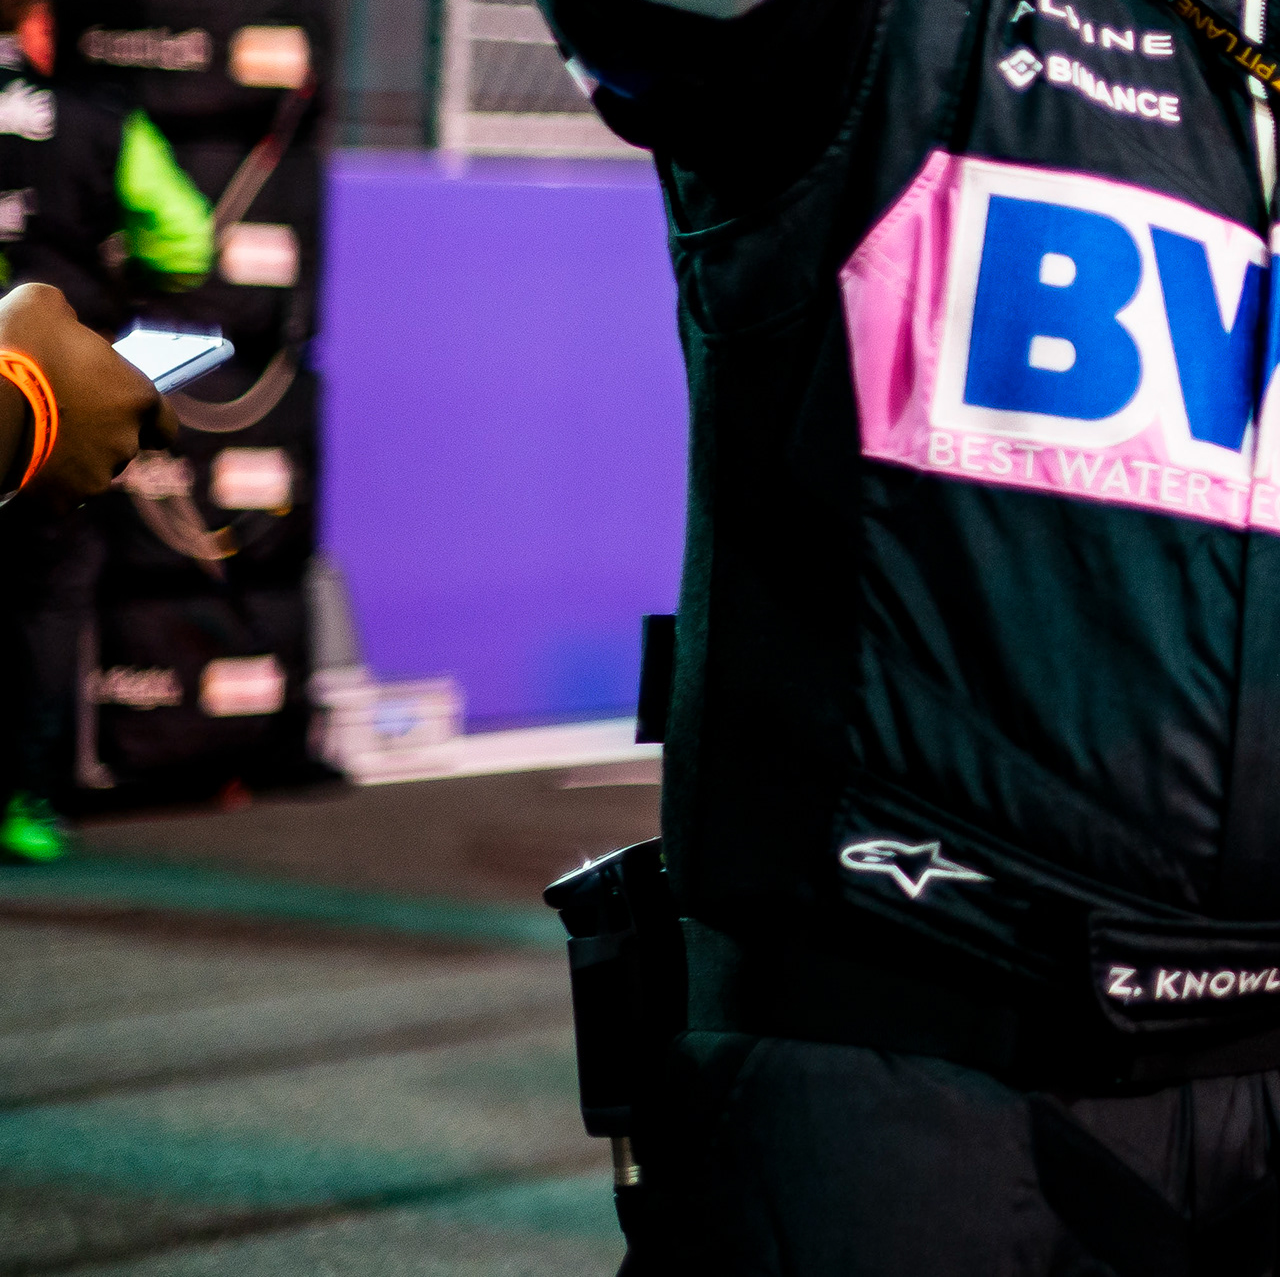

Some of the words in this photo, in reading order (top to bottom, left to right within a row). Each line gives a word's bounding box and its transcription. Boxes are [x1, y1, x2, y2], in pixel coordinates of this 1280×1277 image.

[1048, 55, 1181, 122] BINANCE
[1234, 46, 1278, 81] PIT
[927, 430, 1043, 480] BEST
[1056, 446, 1213, 511] WATER
[1108, 965, 1142, 998] Z.
